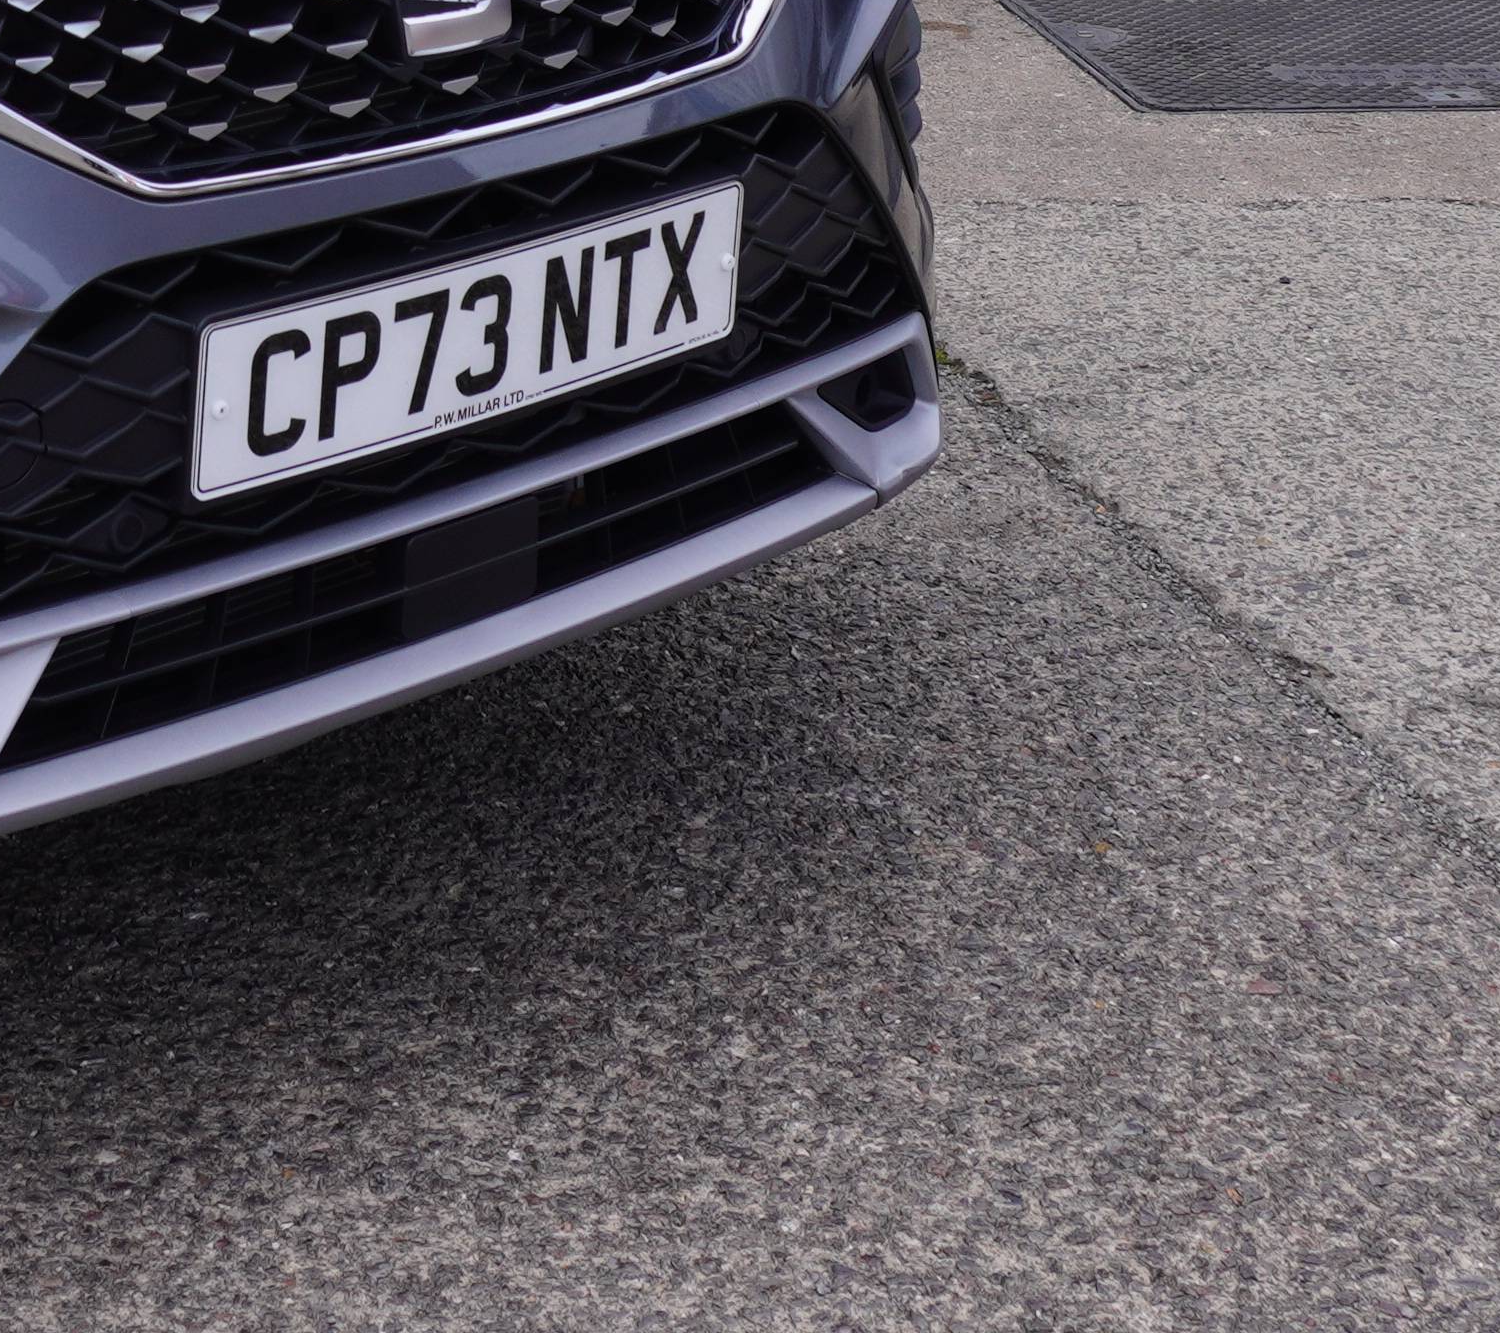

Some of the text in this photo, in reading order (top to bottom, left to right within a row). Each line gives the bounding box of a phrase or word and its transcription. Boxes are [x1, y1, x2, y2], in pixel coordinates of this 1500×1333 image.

[246, 210, 706, 457] CP73 NTX
[503, 389, 525, 415] LTD
